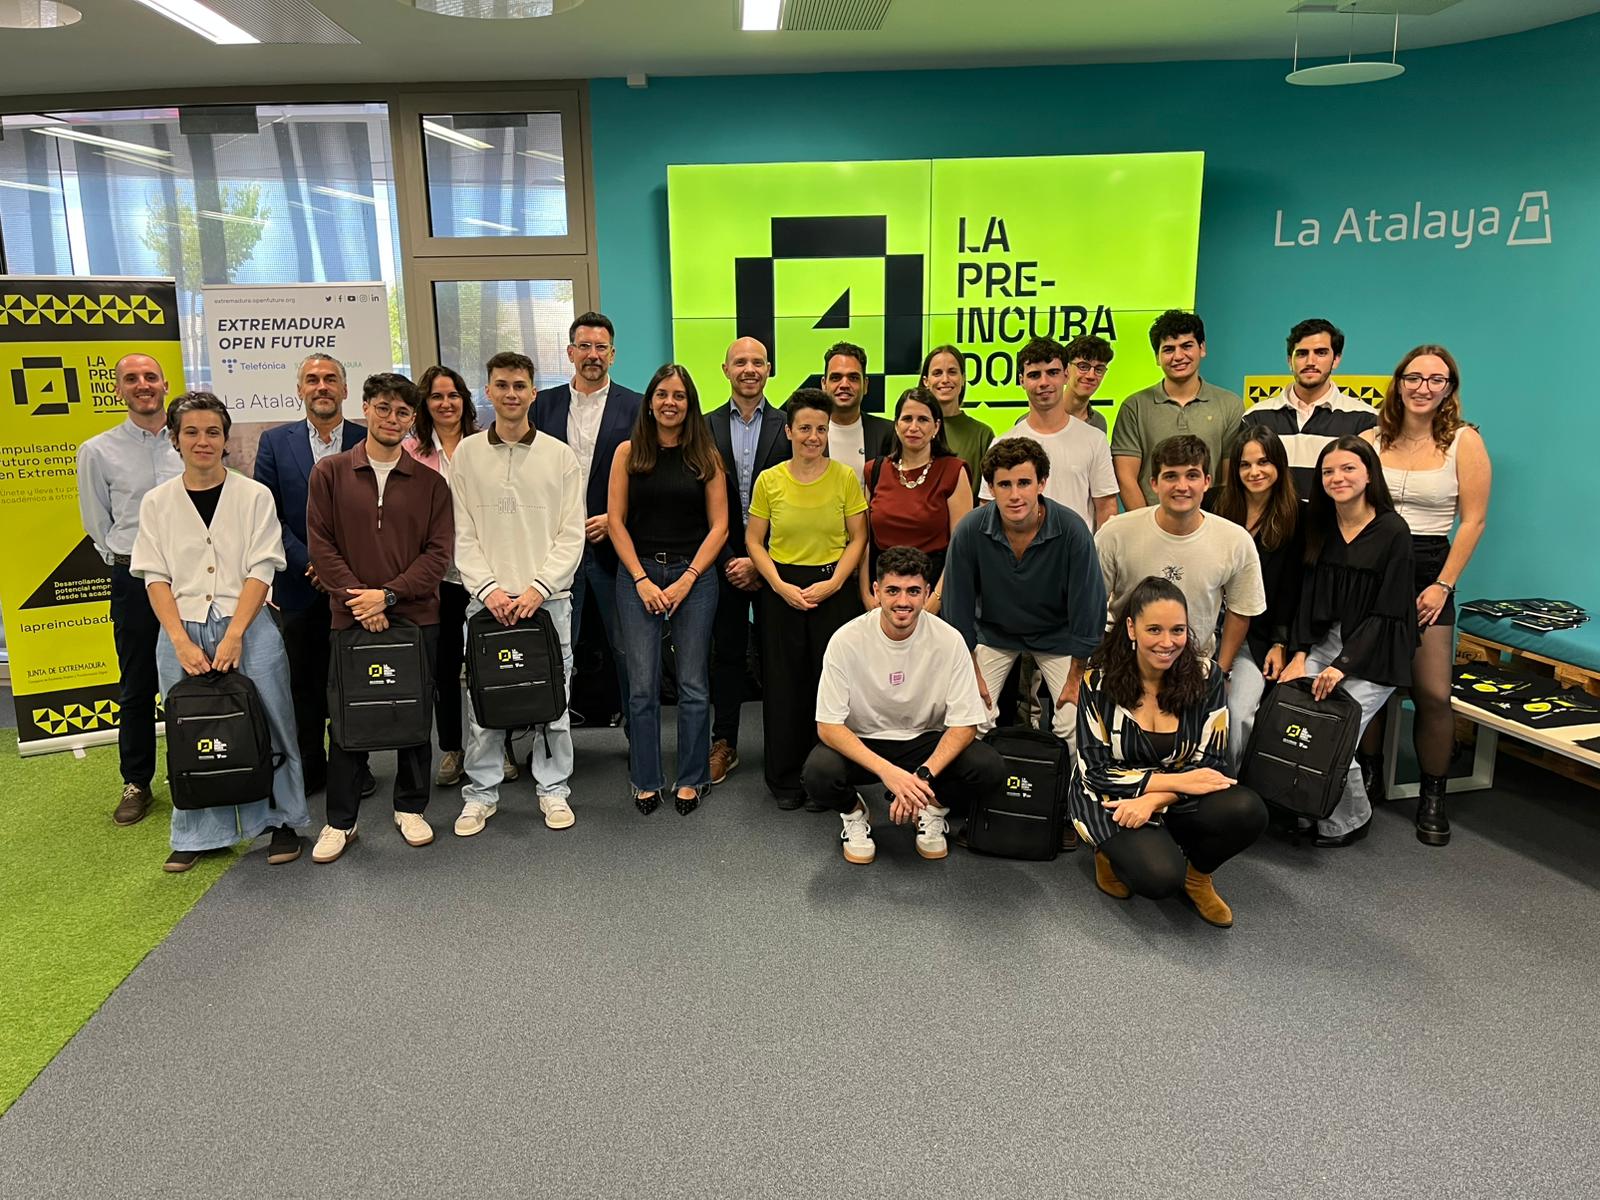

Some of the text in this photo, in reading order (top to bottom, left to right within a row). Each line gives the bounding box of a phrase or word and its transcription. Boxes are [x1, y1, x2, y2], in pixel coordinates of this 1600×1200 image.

[1274, 201, 1500, 249] La Atalaya
[958, 216, 1010, 253] LA
[957, 261, 1055, 298] PRE-
[218, 317, 346, 332] EXTREMADURA
[956, 305, 1117, 344] INCUBA
[219, 335, 336, 350] OPEN FUTURE
[87, 356, 106, 367] LA
[240, 361, 286, 371] Telefónica
[92, 395, 128, 406] DOR
[224, 394, 245, 410] La
[0, 442, 77, 456] mpulsando
[0, 456, 40, 467] uturo
[0, 471, 14, 479] en
[54, 577, 105, 588] Desarrollando
[55, 585, 90, 595] potencial
[27, 669, 46, 678] JUNTA
[58, 661, 106, 673] EXTREMADURA
